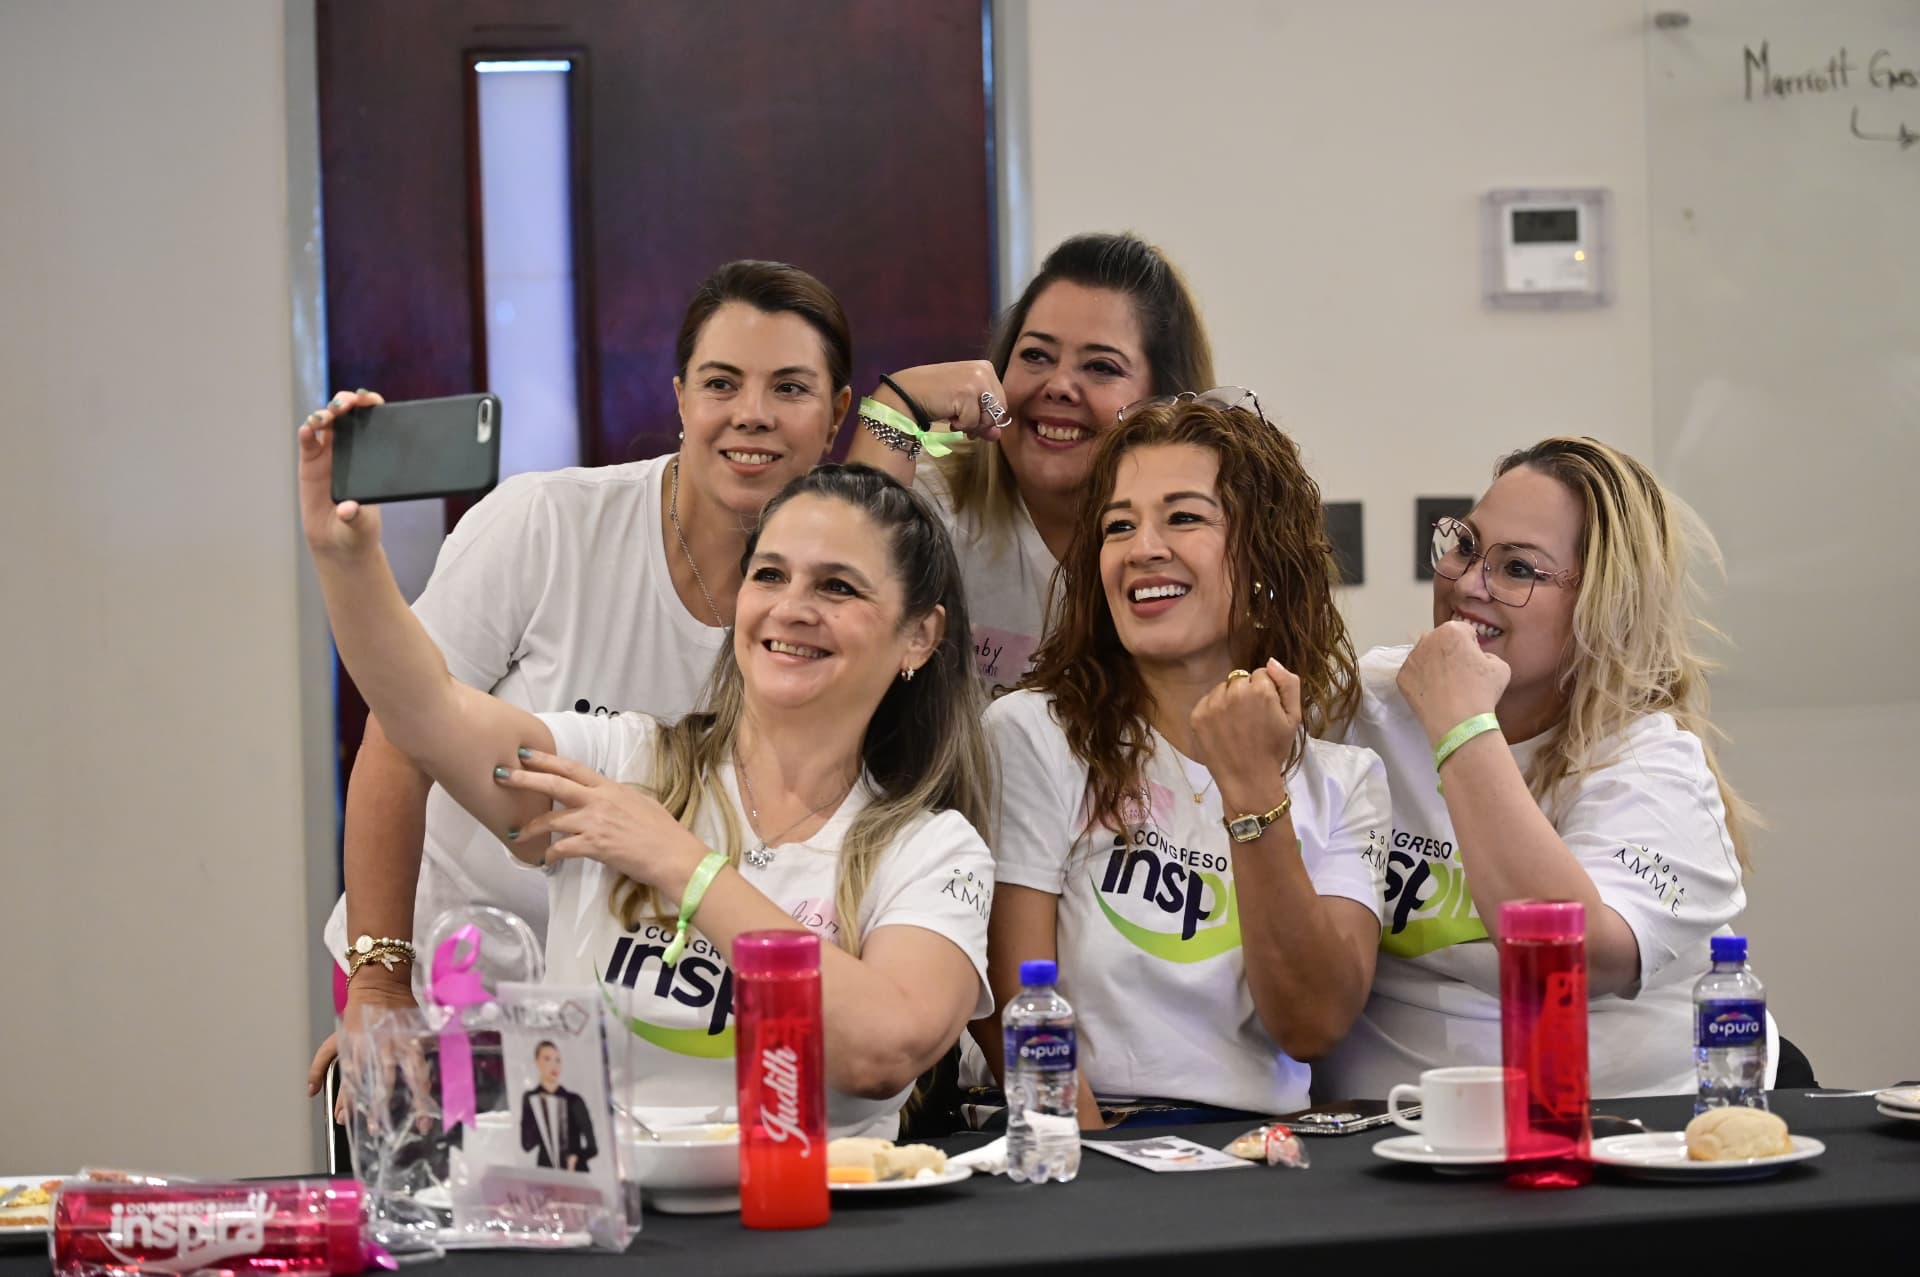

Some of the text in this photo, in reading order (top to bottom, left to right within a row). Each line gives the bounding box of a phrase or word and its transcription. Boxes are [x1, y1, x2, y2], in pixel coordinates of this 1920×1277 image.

[1744, 39, 1858, 102] Marriott
[1134, 829, 1228, 873] CONGRESO
[1392, 829, 1453, 859] GRESO
[760, 1045, 810, 1158] Judith
